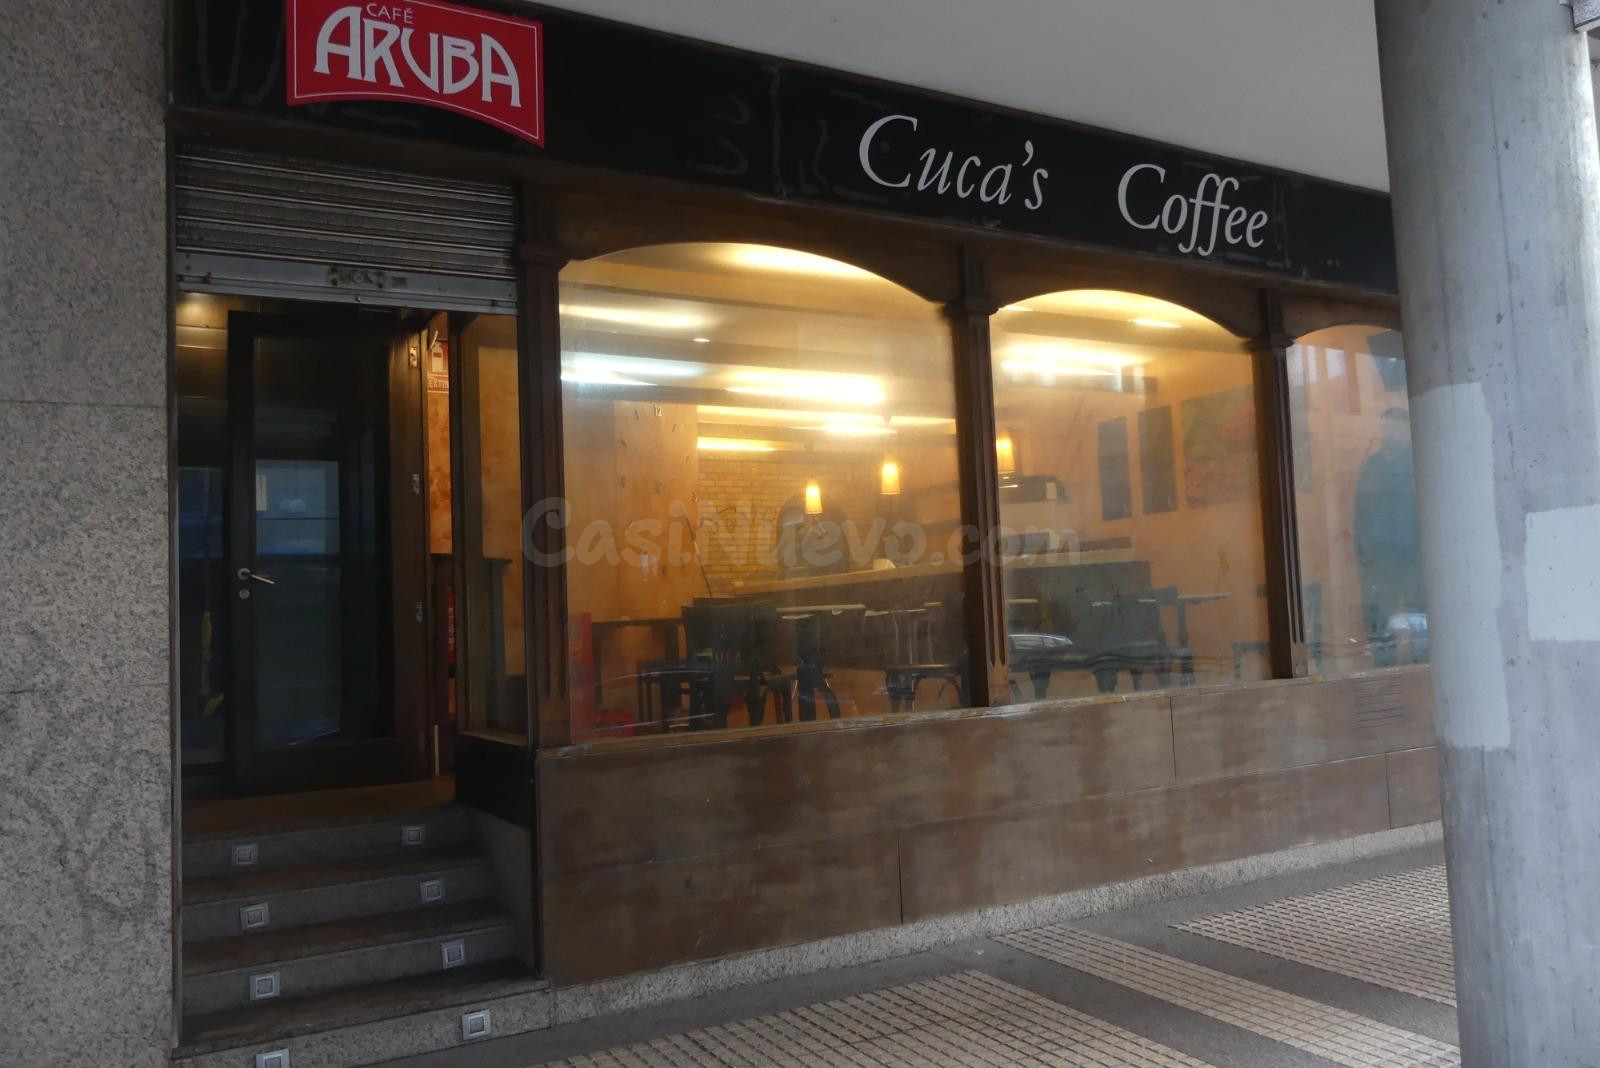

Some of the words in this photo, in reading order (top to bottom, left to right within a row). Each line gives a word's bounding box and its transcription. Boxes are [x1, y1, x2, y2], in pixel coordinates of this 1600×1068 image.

[313, 5, 522, 108] ARUBA
[366, 3, 413, 24] CAFÉ
[858, 114, 1049, 210] Cuca's
[1117, 163, 1268, 257] Coffee
